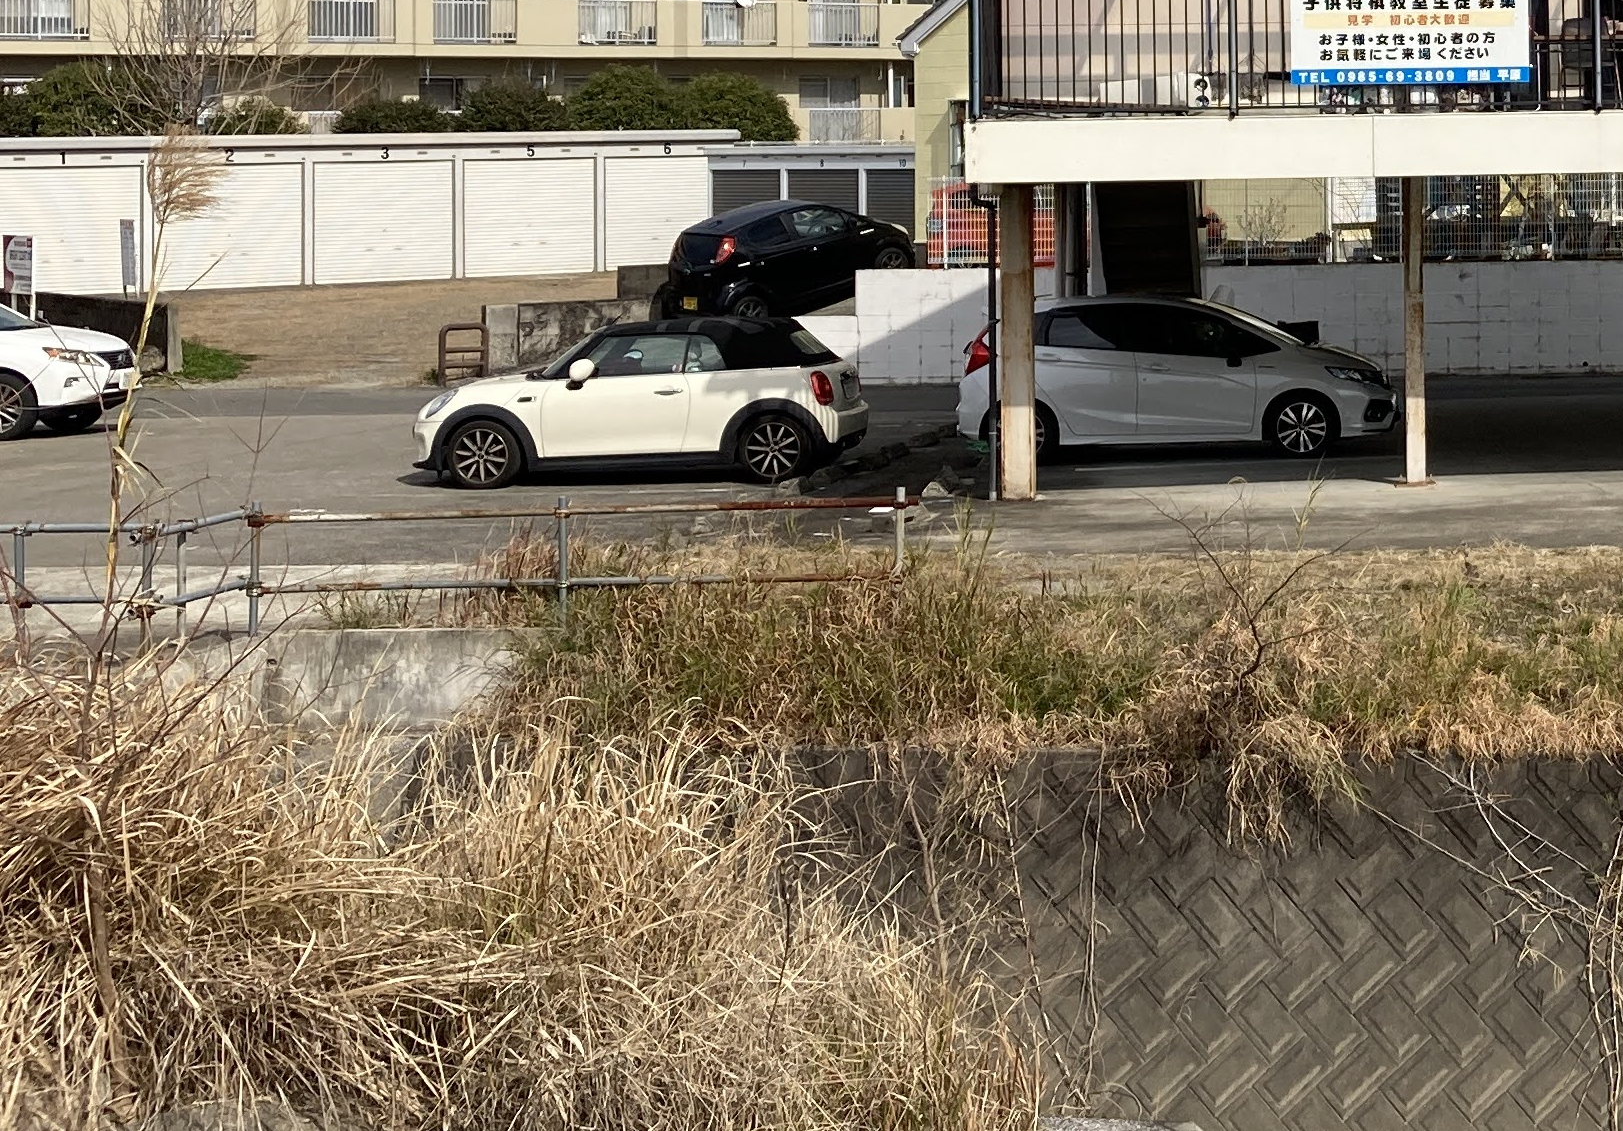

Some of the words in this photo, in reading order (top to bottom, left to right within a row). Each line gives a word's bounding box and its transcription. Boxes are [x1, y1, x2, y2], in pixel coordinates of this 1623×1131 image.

[1298, 71, 1330, 83] TEL
[224, 148, 235, 162] 2
[380, 147, 390, 161] 3
[526, 144, 535, 158] 5
[662, 143, 672, 156] 6
[59, 151, 66, 165] 1
